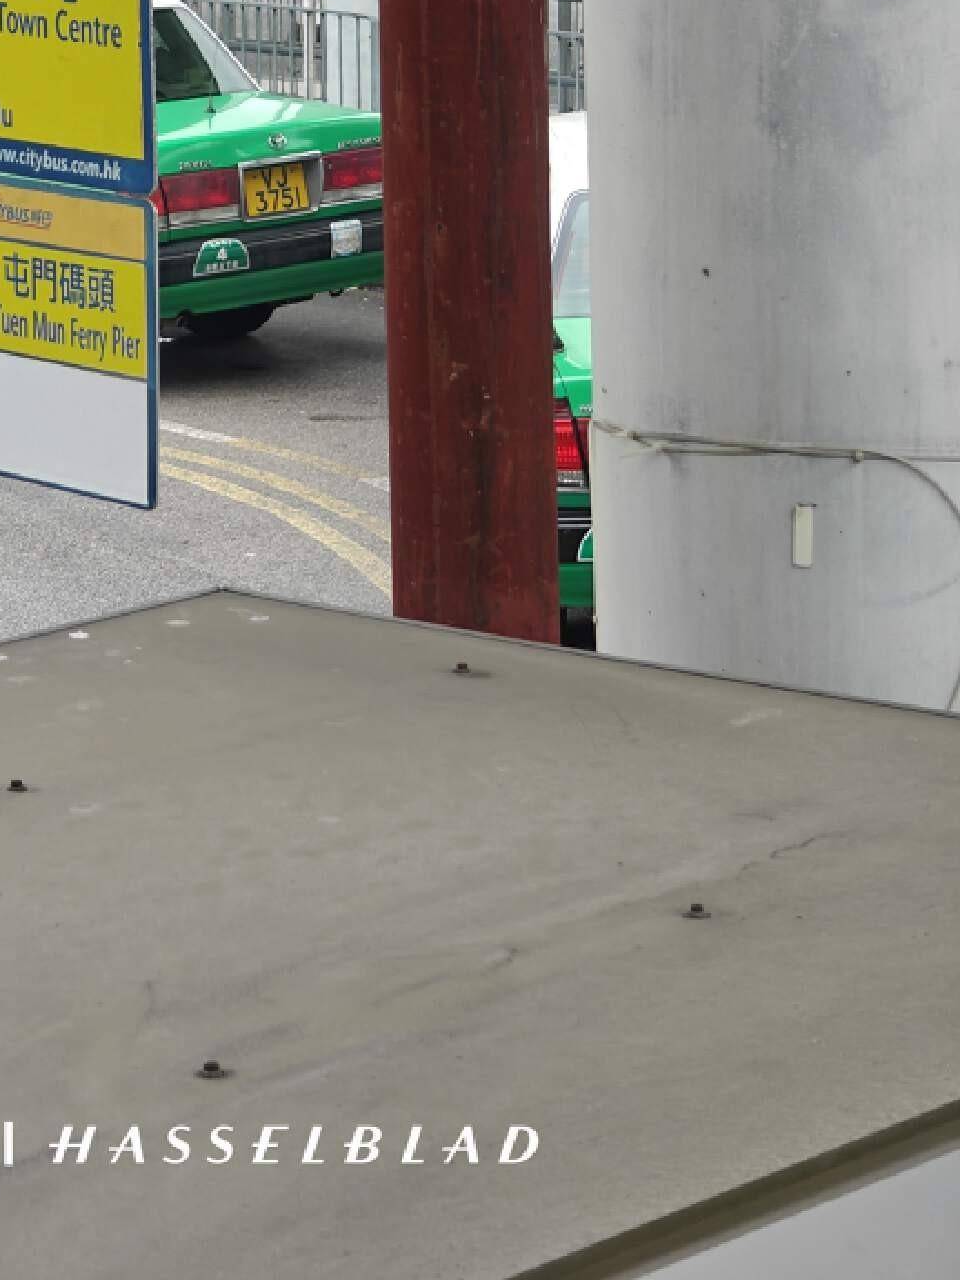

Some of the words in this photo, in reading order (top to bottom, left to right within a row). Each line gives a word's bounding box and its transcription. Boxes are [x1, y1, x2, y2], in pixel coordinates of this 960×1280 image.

[55, 9, 123, 49] Centre
[2, 251, 116, 313] 屯門碼頭
[33, 310, 65, 345] Mun
[71, 318, 107, 362] Ferry
[112, 326, 141, 360] Pier
